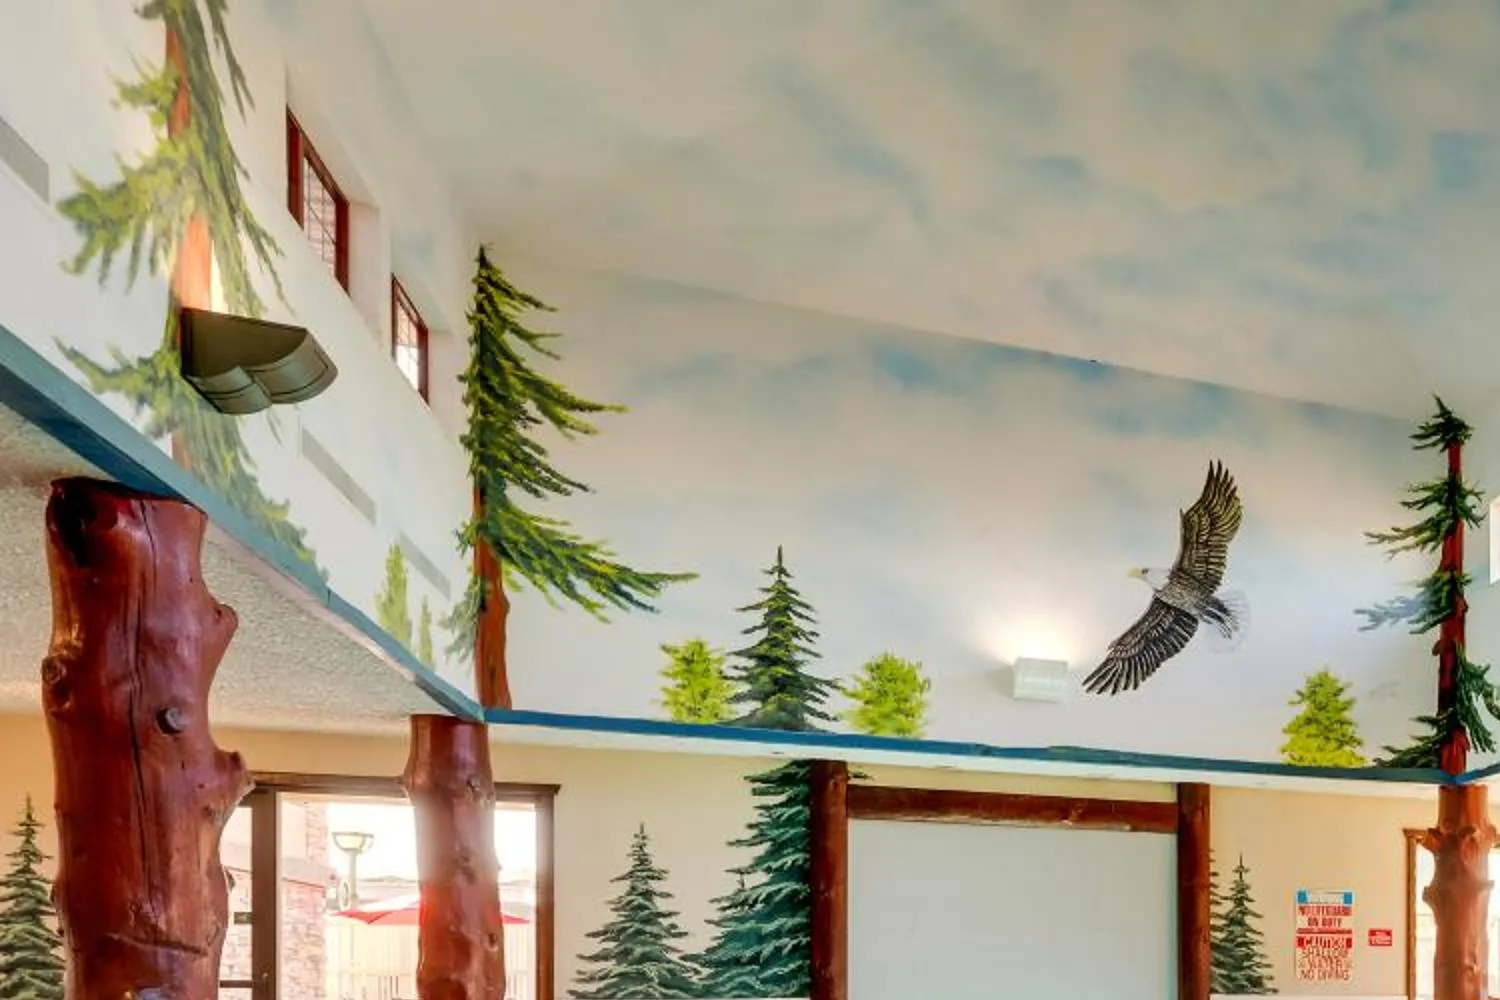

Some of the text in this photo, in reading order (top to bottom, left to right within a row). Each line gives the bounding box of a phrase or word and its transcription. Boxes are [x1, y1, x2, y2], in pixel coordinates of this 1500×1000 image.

[1308, 917, 1342, 927] ON DUTY
[1306, 936, 1346, 948] CAUTION
[1301, 946, 1349, 958] SHALLOW
[1309, 957, 1345, 969] WATER
[1301, 969, 1350, 981] NO DIVING
